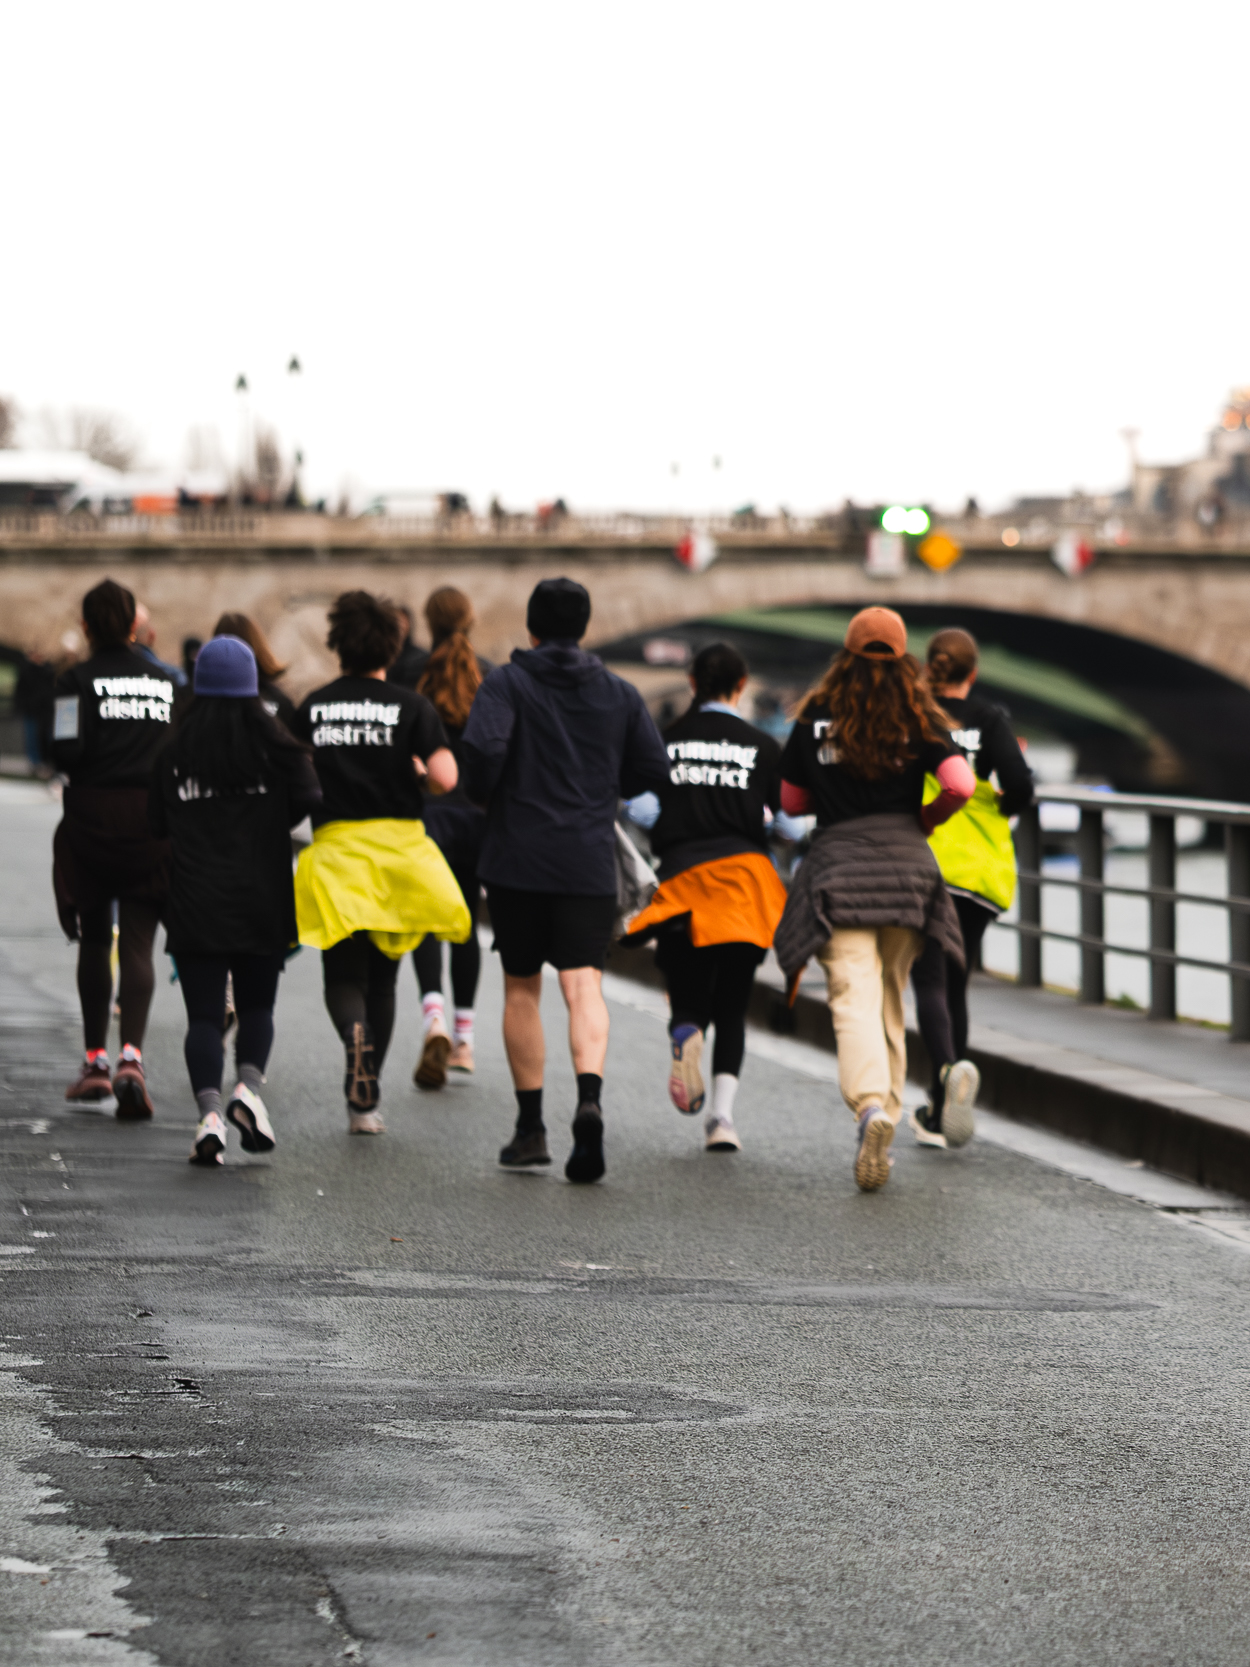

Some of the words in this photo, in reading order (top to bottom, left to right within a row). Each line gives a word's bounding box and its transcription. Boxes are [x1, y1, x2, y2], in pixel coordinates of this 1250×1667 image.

[310, 698, 402, 726] running
[312, 723, 394, 748] district
[666, 739, 760, 770] running
[669, 763, 751, 790] district
